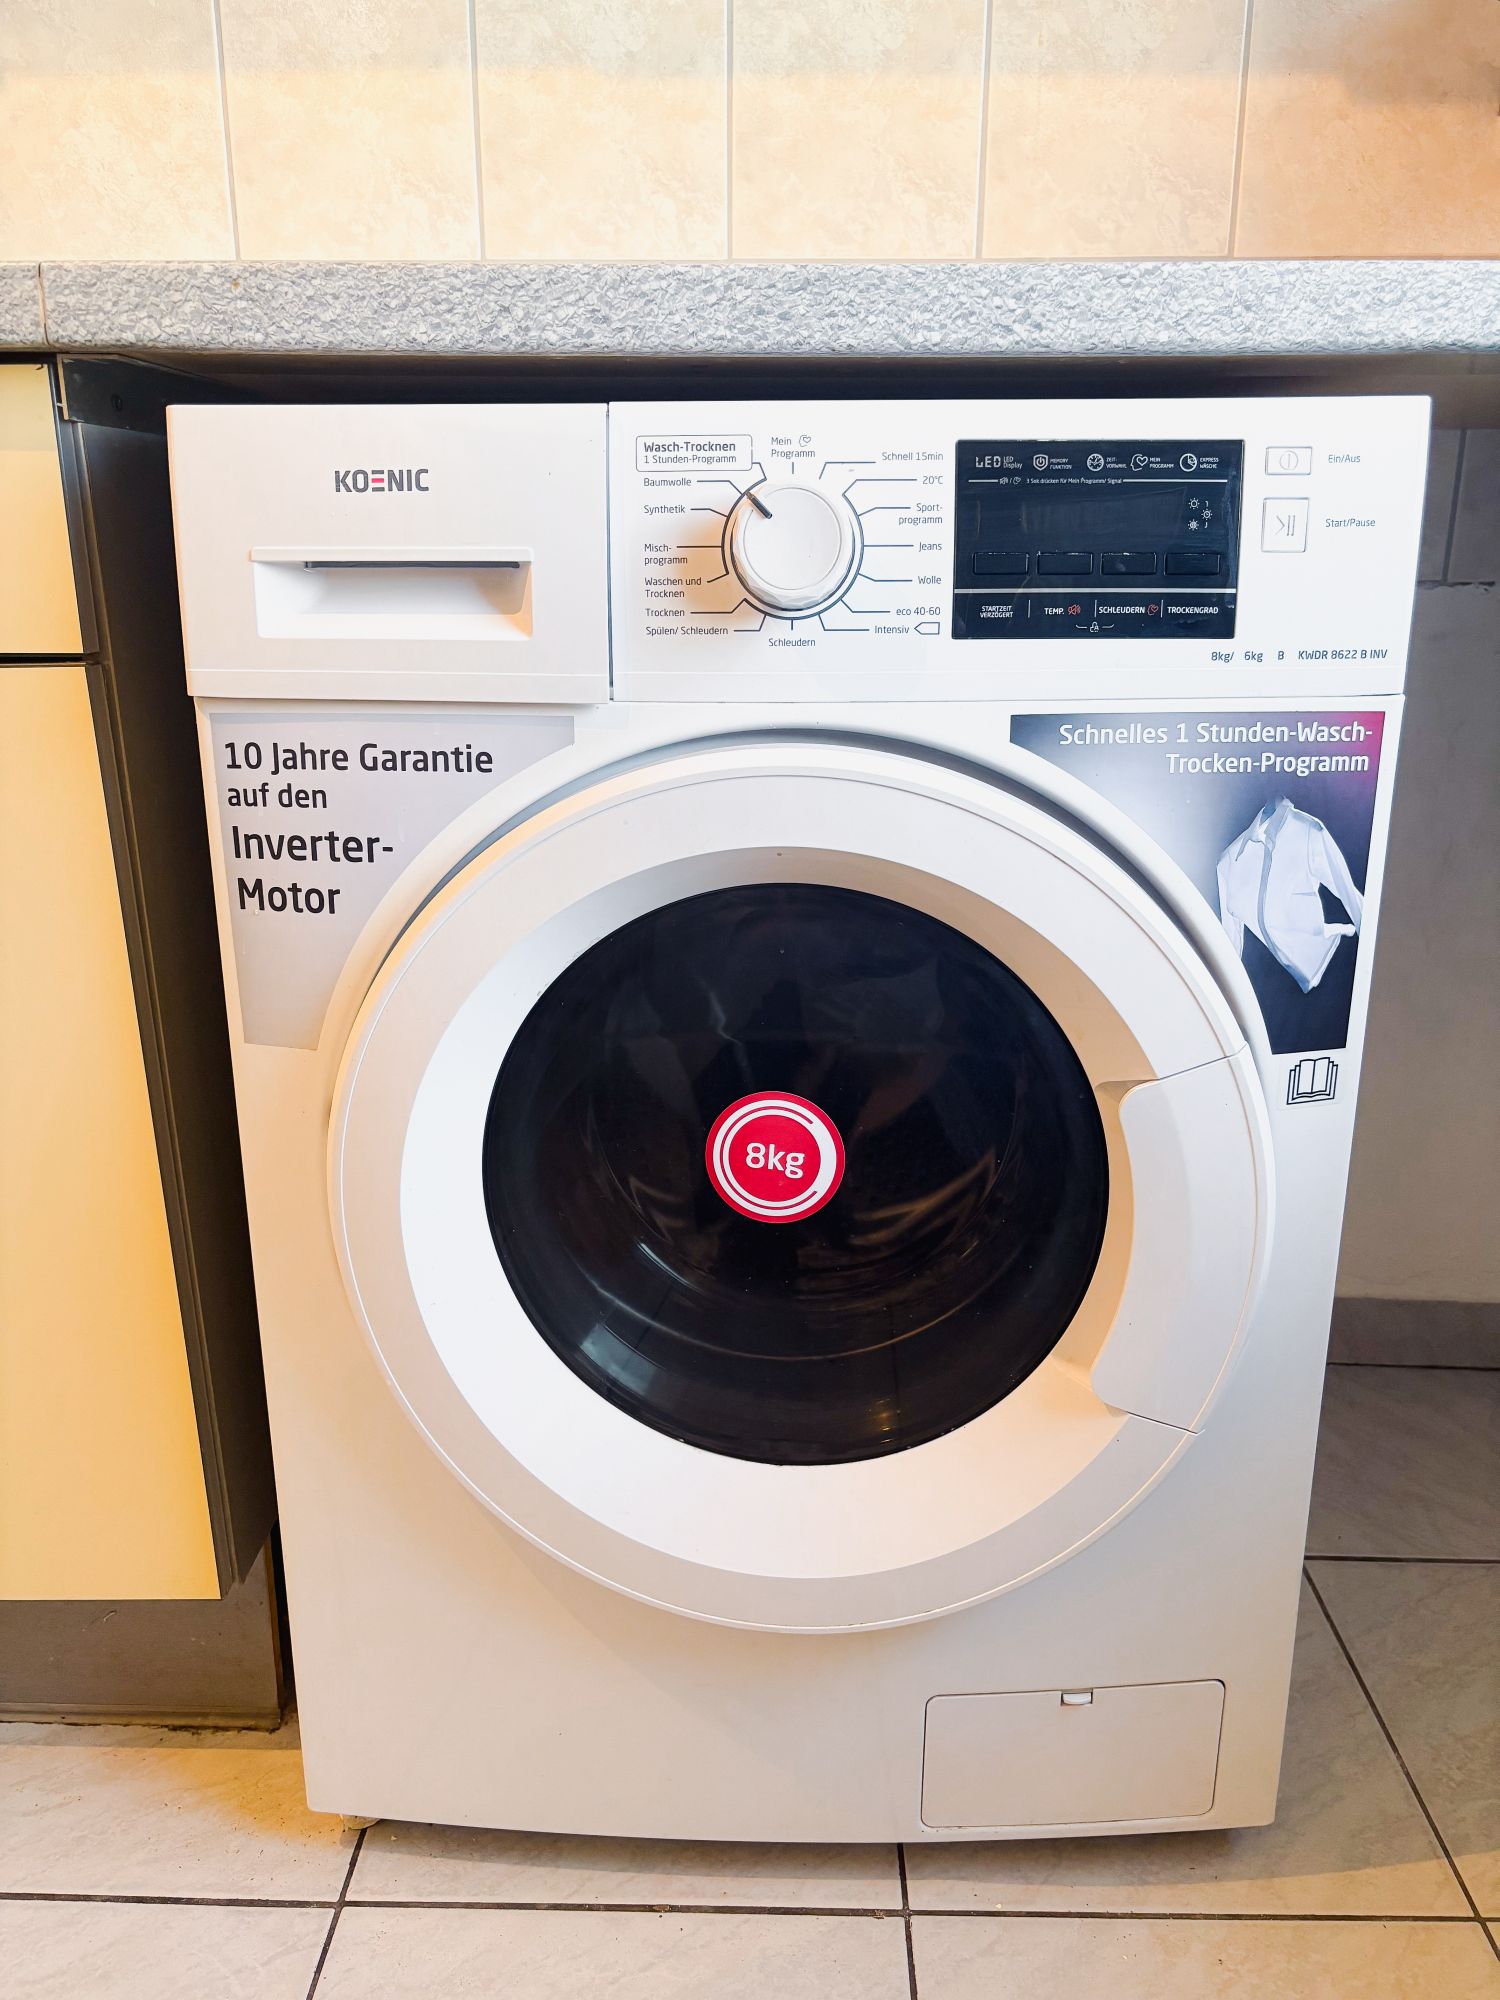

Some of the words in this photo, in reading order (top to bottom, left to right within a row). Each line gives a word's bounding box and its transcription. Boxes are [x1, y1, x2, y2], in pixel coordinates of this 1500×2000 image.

[771, 437, 791, 445] Mein
[644, 442, 736, 452] Wasch-Trocknen
[771, 449, 815, 459] Programm
[882, 452, 913, 460] Schnell
[916, 452, 943, 460] 15min
[644, 455, 649, 463] 1
[653, 455, 736, 464] Stunden-Programm
[1328, 455, 1360, 463] Ein/Aus
[335, 469, 429, 493] KOENIC
[644, 478, 691, 486] Baumwolle
[923, 476, 943, 484] 20°C
[644, 504, 685, 514] Synthetik
[916, 503, 942, 513] Sport-
[899, 516, 942, 525] programm
[1326, 519, 1375, 528] Start/Pause
[645, 544, 671, 552] Misch-
[919, 542, 942, 551] Jeans
[644, 556, 687, 566] programm
[645, 577, 683, 586] Waschen
[685, 577, 701, 586] und
[918, 576, 941, 584] Wolle
[645, 589, 684, 598] Trocknen
[645, 609, 685, 617] Trocknen
[914, 607, 940, 616] 40-60
[646, 627, 678, 636] Spülen/
[681, 626, 728, 635] Schleudern
[874, 625, 909, 634] Intensiv
[768, 638, 815, 647] Schleudern
[1211, 652, 1234, 662] 8kg/
[1244, 651, 1263, 662] 6kg
[1278, 651, 1284, 660] B
[1298, 651, 1328, 659] KWDR
[1331, 650, 1357, 659] 8622
[1360, 650, 1367, 659] B
[1370, 650, 1388, 659] INV
[1059, 723, 1168, 745] Schnelles
[1176, 723, 1189, 743] 1
[1197, 721, 1372, 743] Stunden-Wasch-
[225, 742, 262, 769] 10
[271, 742, 348, 775] Jahre
[360, 744, 493, 773] Garantie
[1166, 753, 1369, 777] Trocken-Programm
[228, 783, 269, 807] auf
[278, 783, 327, 808] den
[232, 826, 393, 863] Inverter-
[238, 878, 340, 914] Motor
[746, 1143, 805, 1179] 8kg
